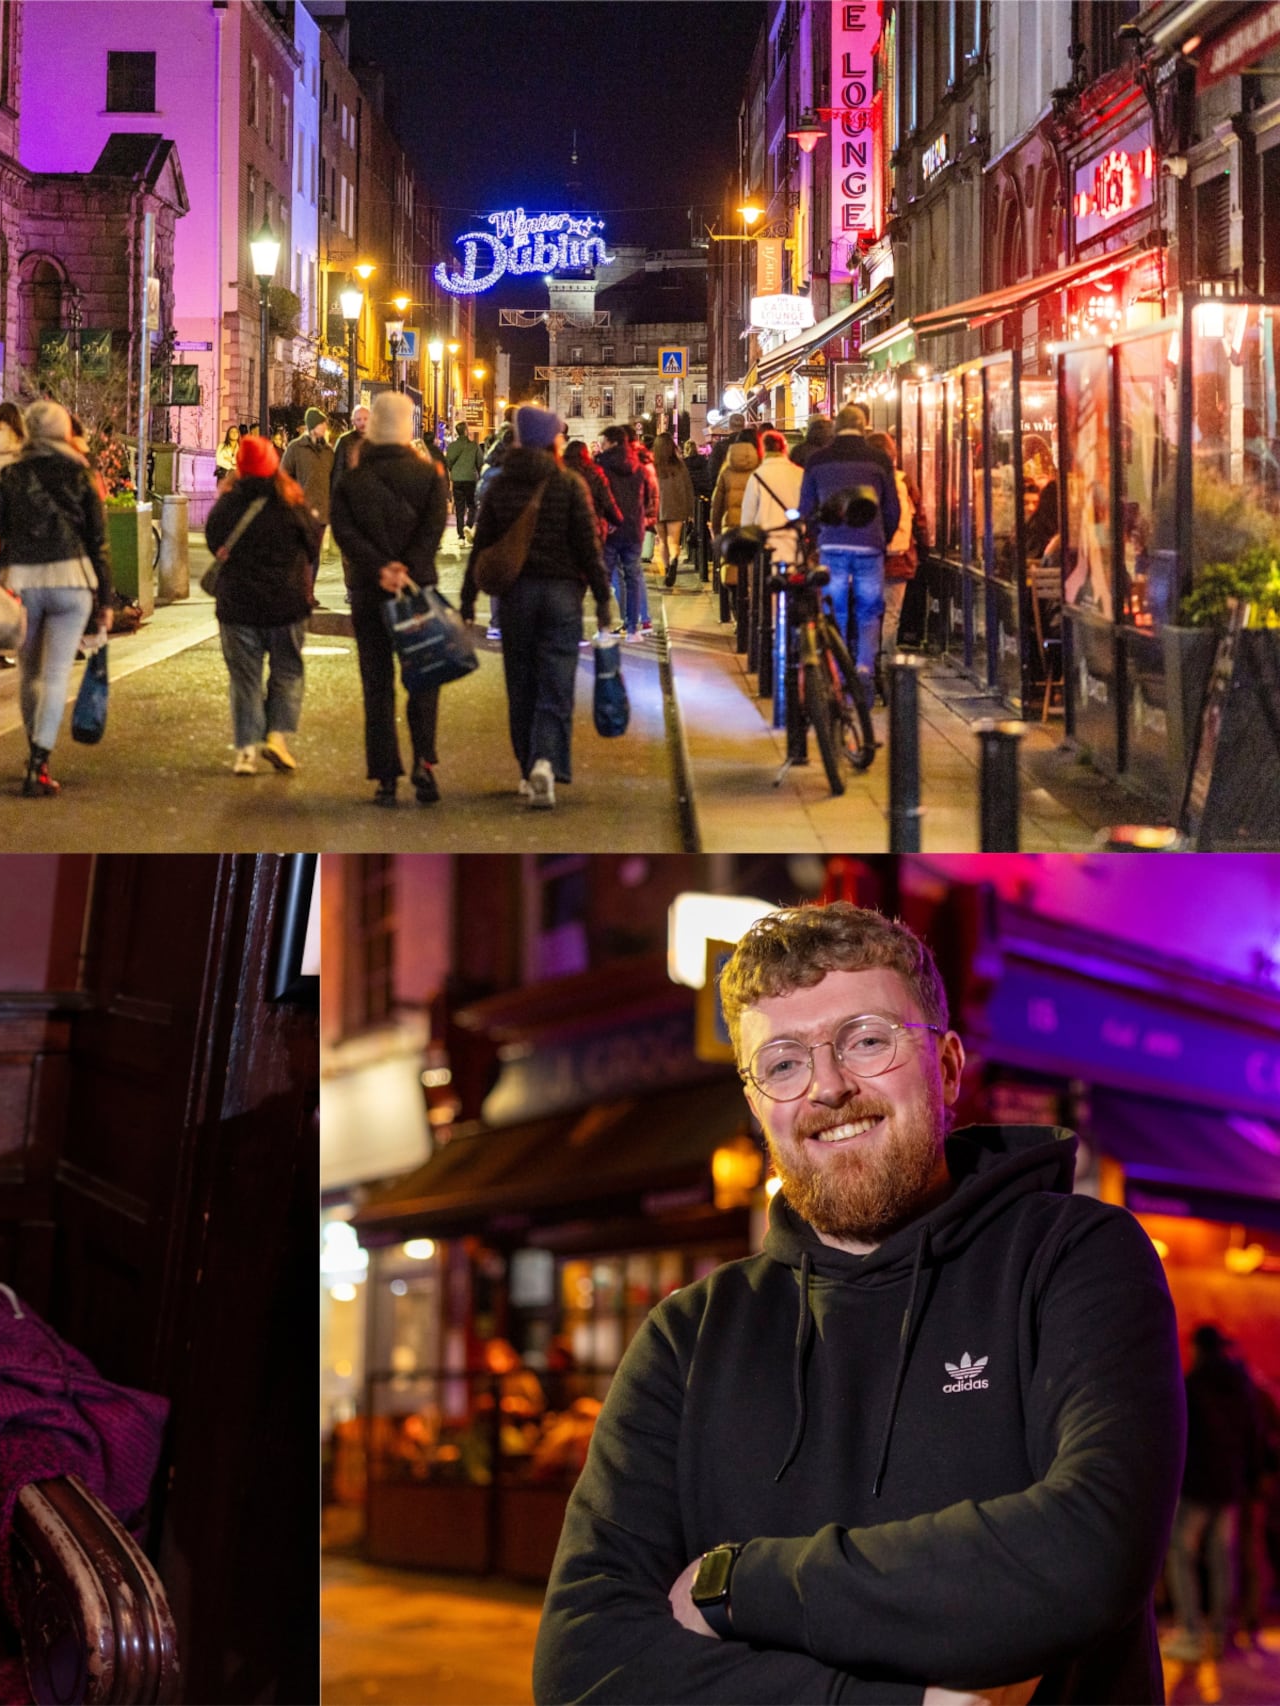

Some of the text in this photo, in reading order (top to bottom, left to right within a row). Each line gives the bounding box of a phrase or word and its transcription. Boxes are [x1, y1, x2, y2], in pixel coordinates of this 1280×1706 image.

[841, 0, 867, 231] E LOUNGE
[488, 207, 570, 239] Winter
[434, 232, 617, 295] Dublin
[761, 246, 777, 291] benefit
[761, 311, 804, 321] LOUNGE
[763, 303, 802, 312] CASTLE
[942, 1379, 989, 1393] adidas
